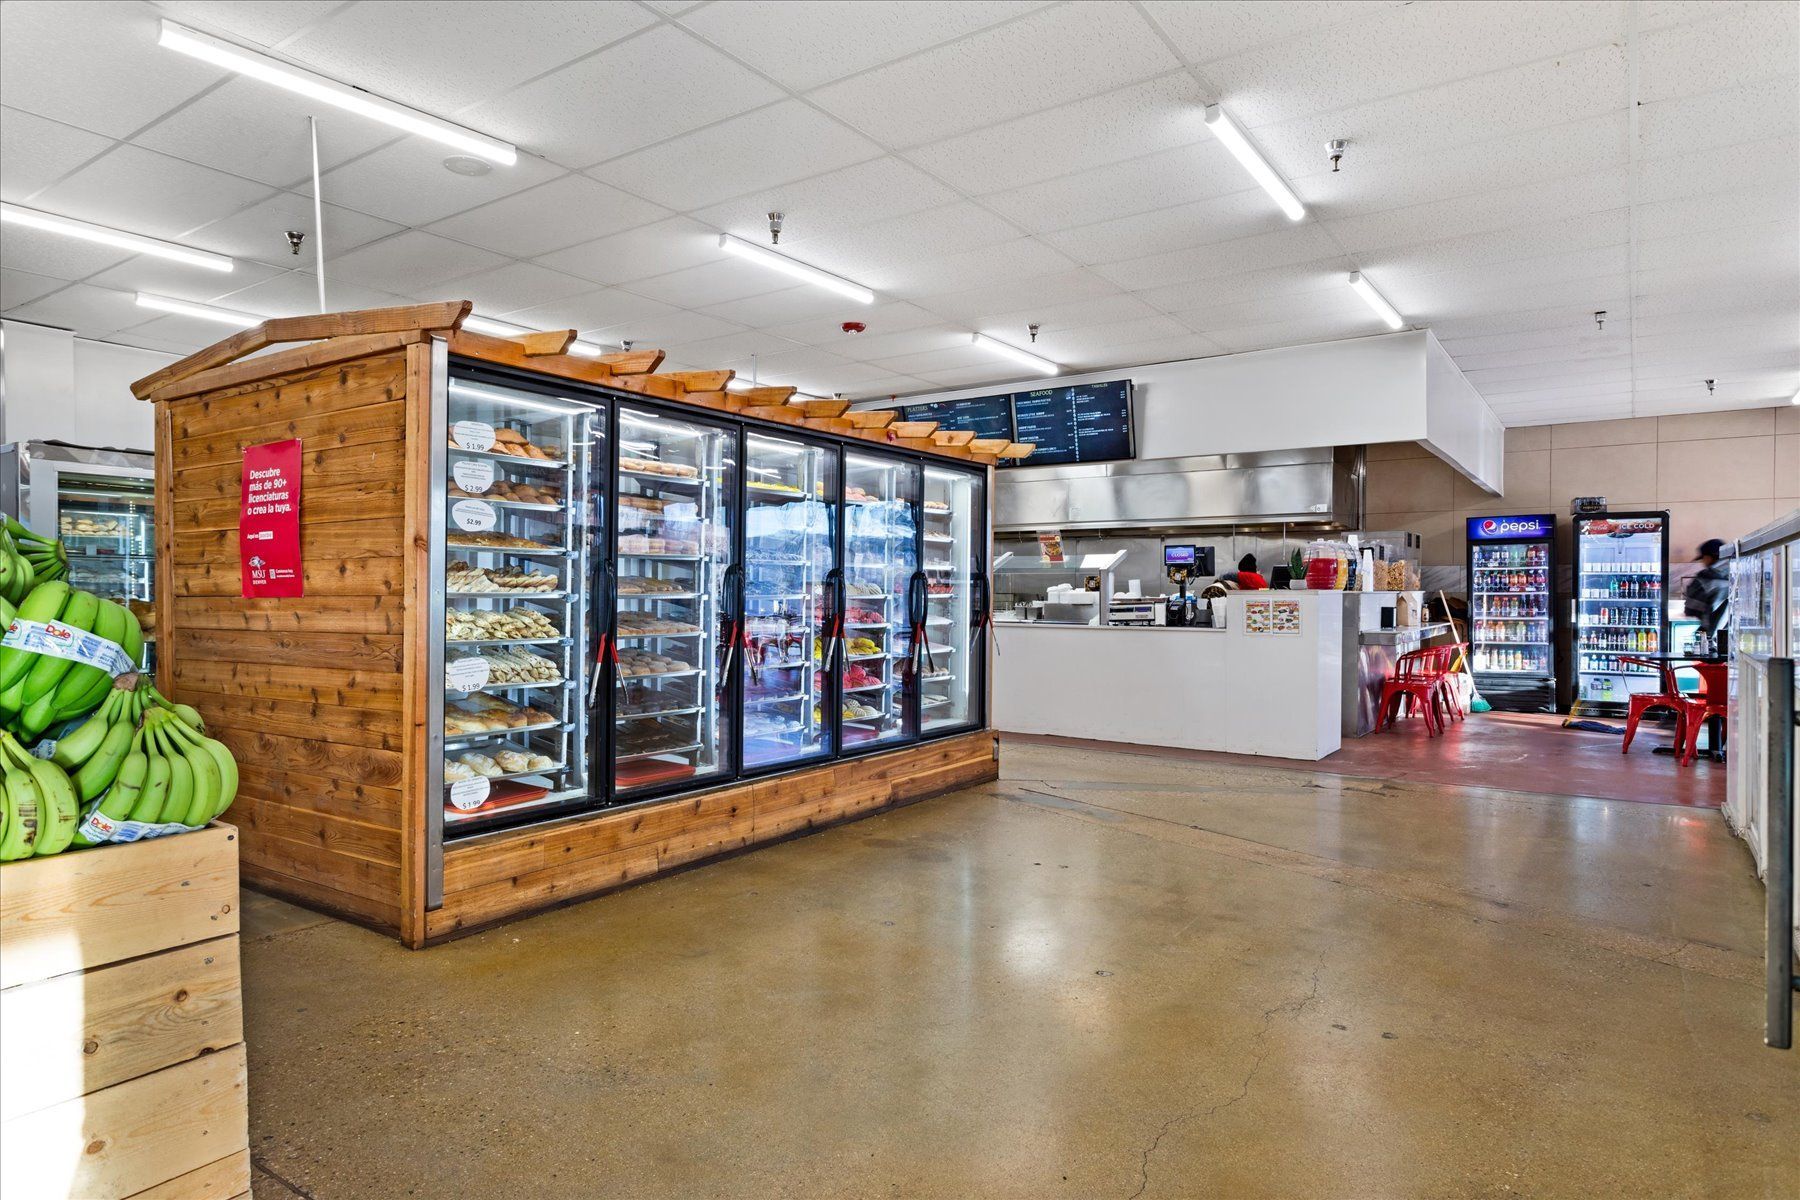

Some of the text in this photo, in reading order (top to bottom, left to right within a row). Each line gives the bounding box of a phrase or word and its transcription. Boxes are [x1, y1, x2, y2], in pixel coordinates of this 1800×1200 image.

[250, 468, 280, 480] Descubre
[248, 478, 287, 491] más de 90+
[248, 492, 289, 503] licenciaturas
[253, 506, 266, 514] crea
[268, 504, 274, 513] la
[275, 504, 292, 514] tuya.
[1500, 520, 1539, 533] pepsi
[252, 570, 266, 578] MSU
[46, 625, 71, 638] Dole
[91, 817, 112, 831] Dole
